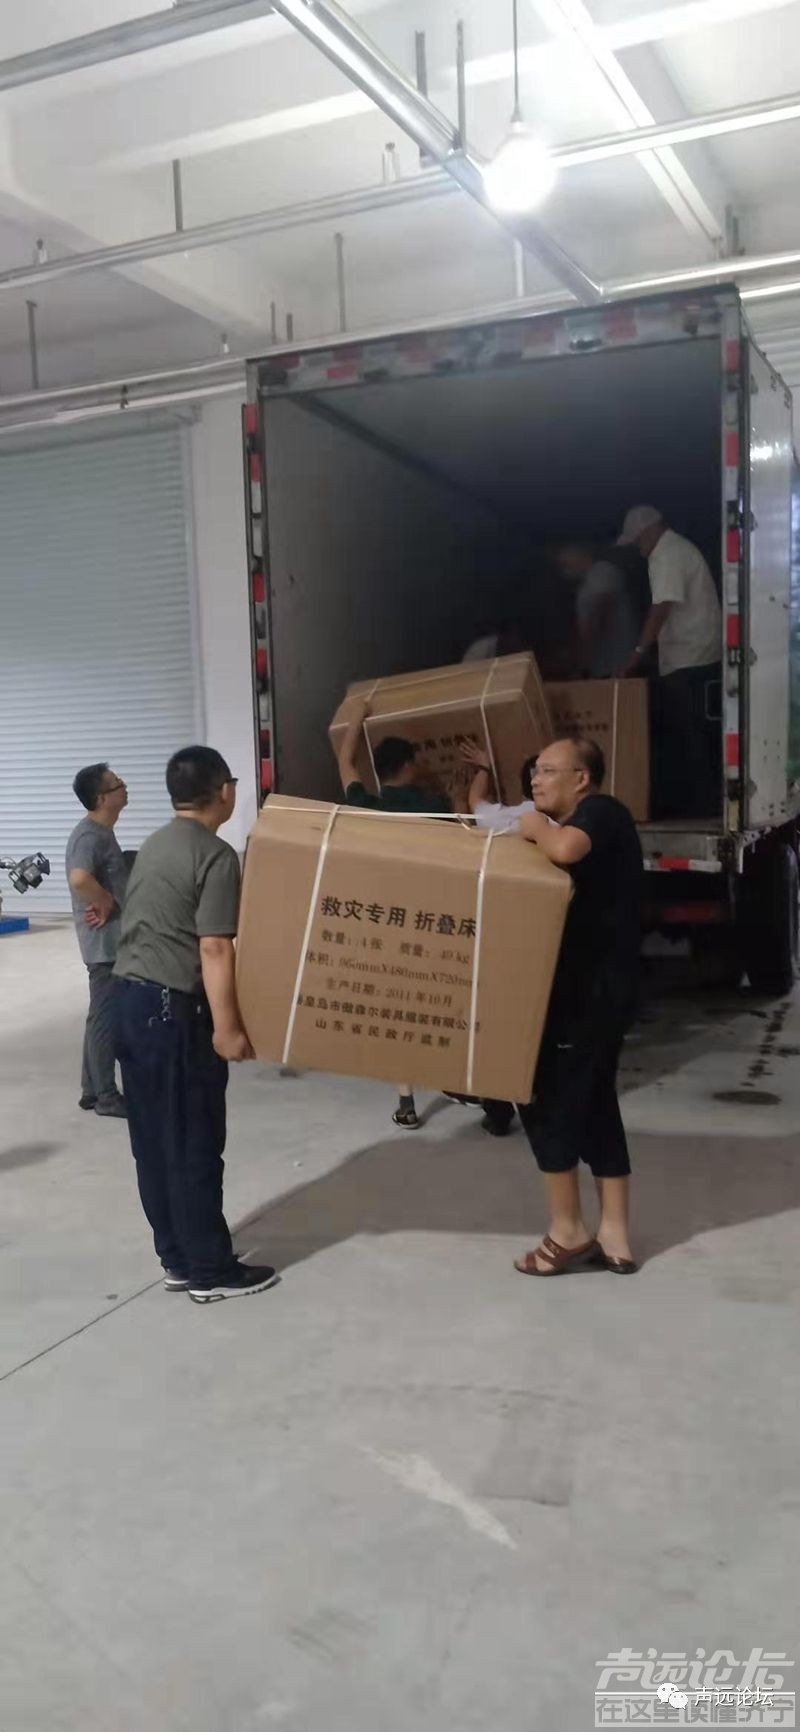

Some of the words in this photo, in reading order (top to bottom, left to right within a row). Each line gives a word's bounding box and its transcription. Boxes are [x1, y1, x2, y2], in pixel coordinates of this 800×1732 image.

[321, 896, 407, 928] 救灾专用
[414, 909, 477, 938] 折叠床
